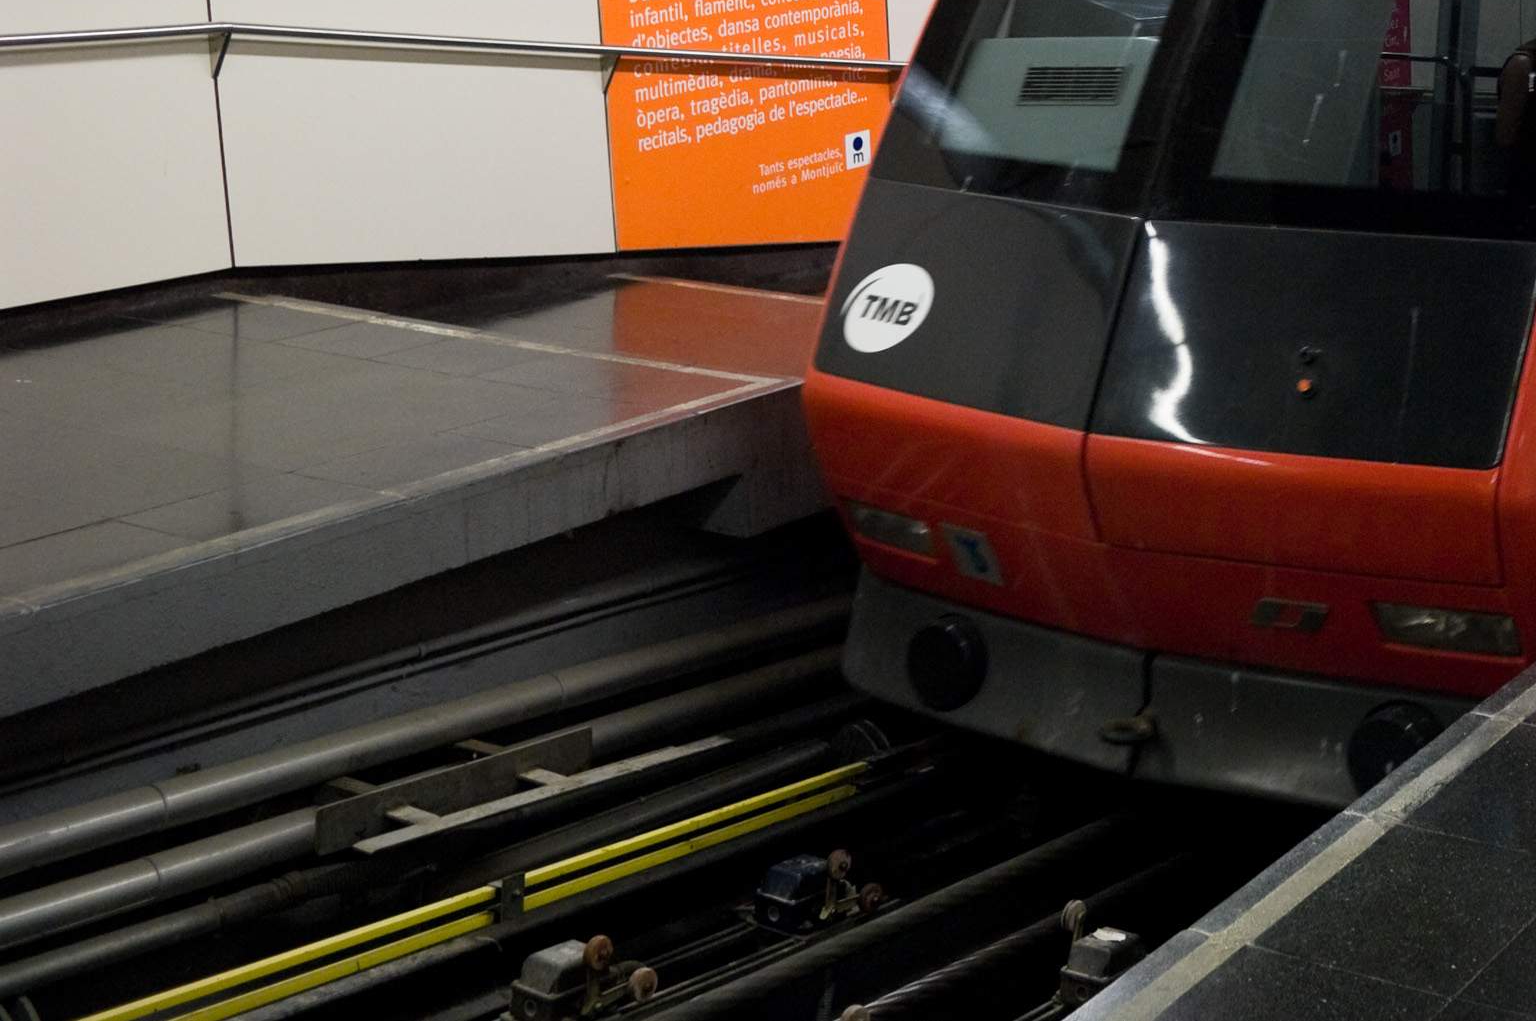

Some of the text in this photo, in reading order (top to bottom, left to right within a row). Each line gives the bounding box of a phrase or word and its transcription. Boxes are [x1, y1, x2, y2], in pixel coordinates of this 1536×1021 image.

[629, 1, 689, 29] infantil,
[632, 26, 713, 49] d'objectes,
[718, 18, 760, 38] dansa
[794, 21, 864, 47] musicals,
[635, 72, 724, 103] multimèdia,
[636, 106, 685, 130] òpera,
[690, 89, 754, 116] tragèdia,
[759, 74, 838, 104] pantomima,
[638, 89, 868, 152] recitals, pedagogia de l'espectacle...
[752, 175, 787, 195] només
[758, 162, 785, 177] Tants
[860, 295, 919, 326] TMB
